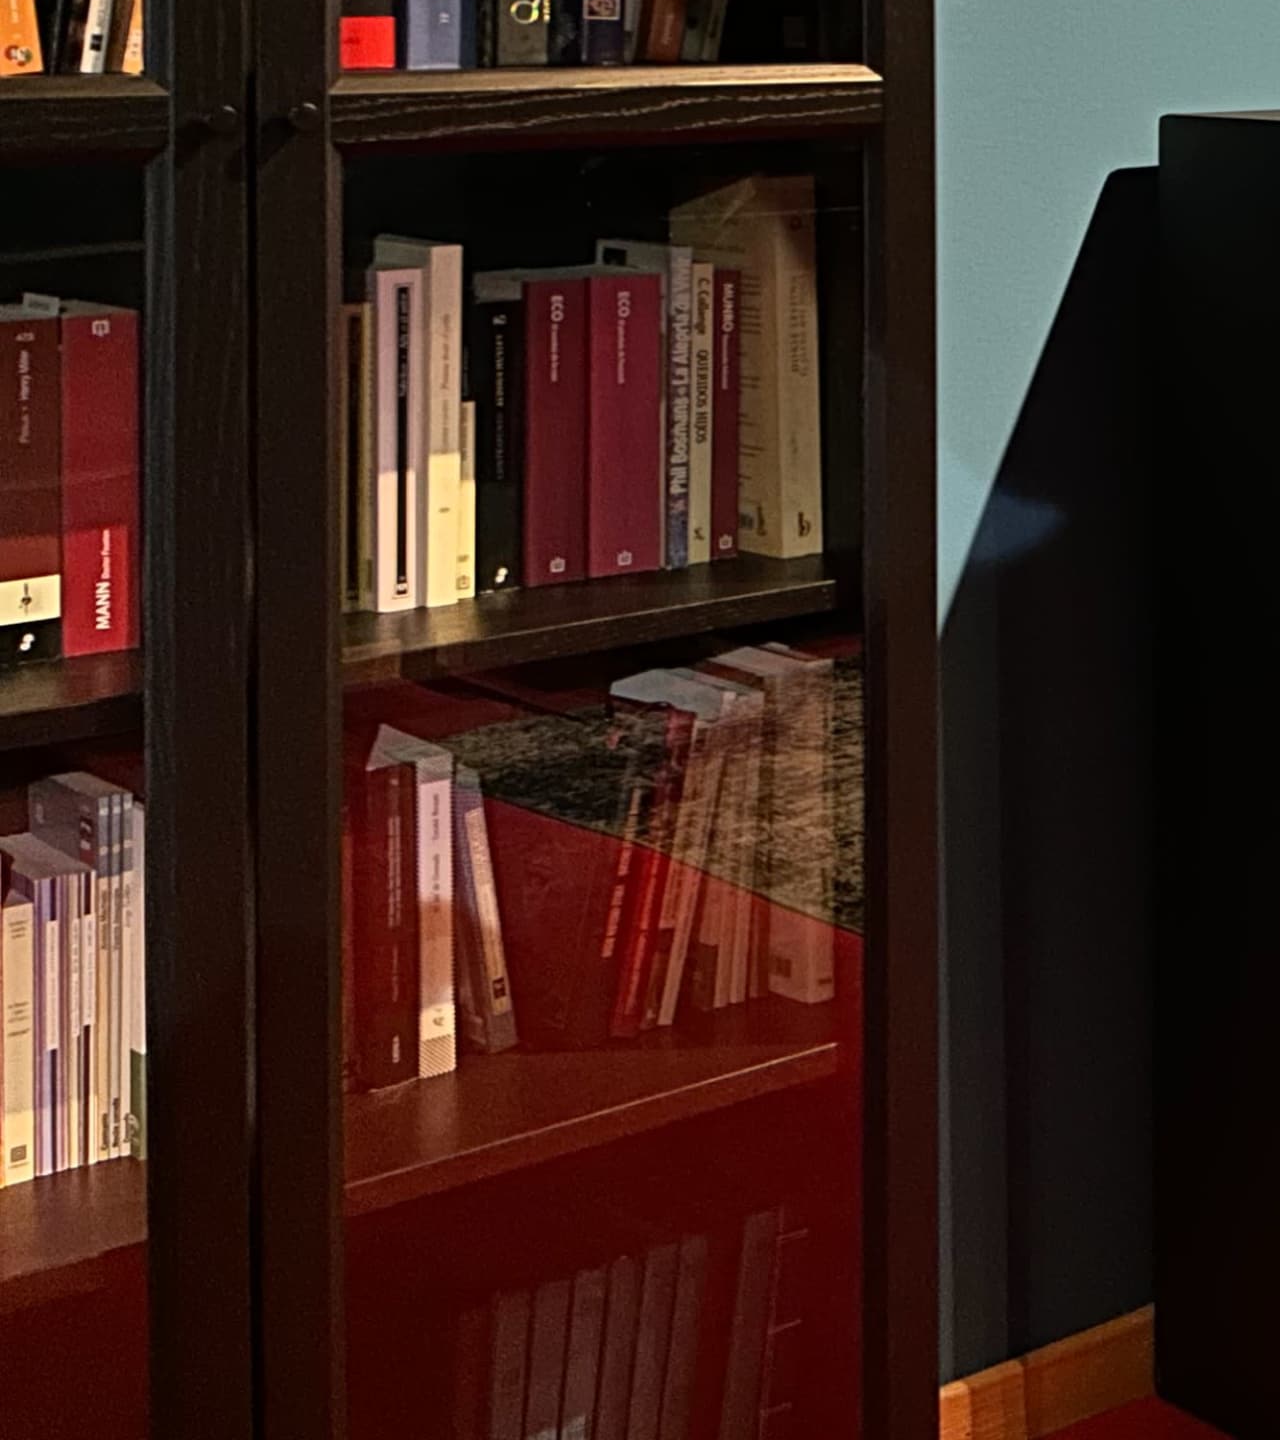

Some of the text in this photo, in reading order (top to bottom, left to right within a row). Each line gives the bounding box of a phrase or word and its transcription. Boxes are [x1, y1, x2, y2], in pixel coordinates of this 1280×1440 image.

[550, 294, 564, 322] ECO
[617, 290, 631, 318] ECO
[722, 283, 735, 333] MUNRO
[671, 367, 689, 385] La
[696, 349, 709, 408] QUERIDOS
[670, 398, 690, 464] Bosmans
[695, 411, 708, 444] HIJOS
[669, 465, 688, 495] Phil
[95, 581, 111, 631] MANN
